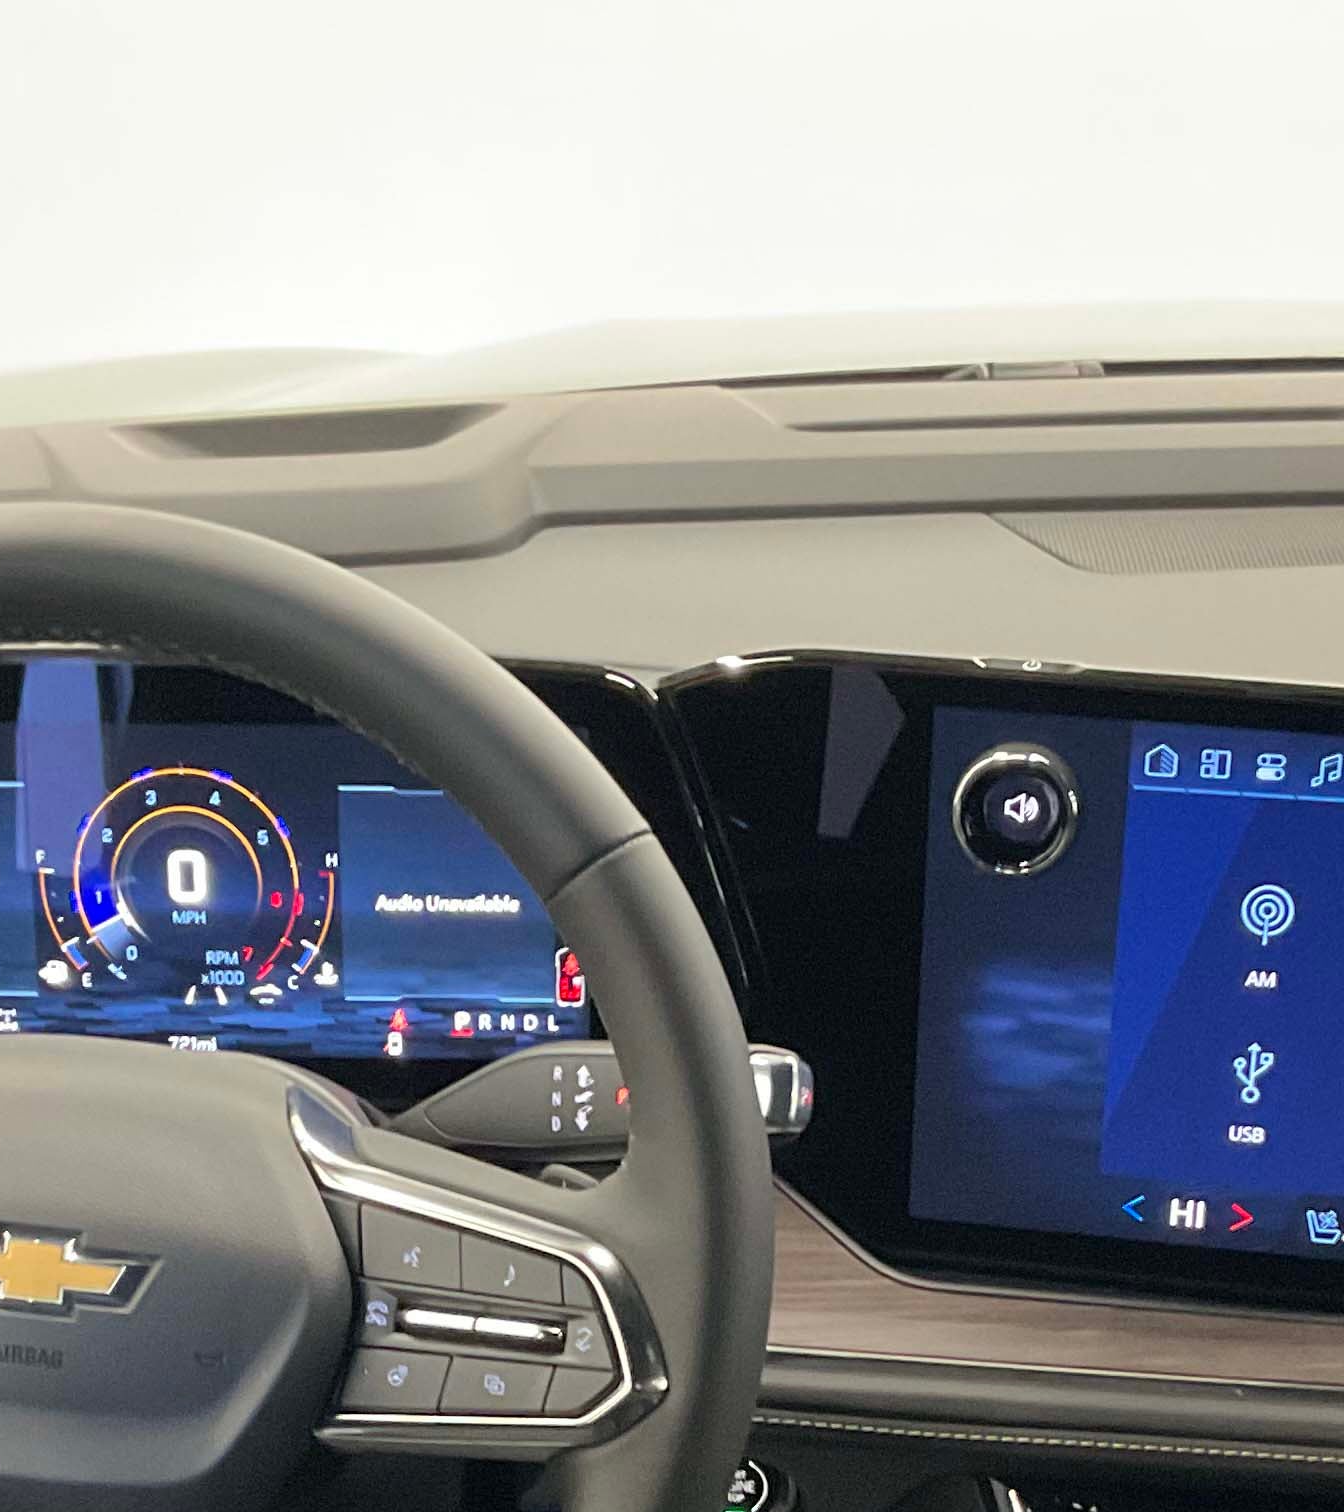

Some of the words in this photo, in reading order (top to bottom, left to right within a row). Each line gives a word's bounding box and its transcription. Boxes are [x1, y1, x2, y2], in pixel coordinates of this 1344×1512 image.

[145, 789, 157, 805] 3
[209, 789, 222, 805] 4
[101, 827, 113, 843] 2
[257, 829, 269, 846] 5
[35, 849, 46, 864] F
[325, 853, 340, 868] H
[166, 848, 207, 904] 0
[374, 894, 424, 912] Audio
[425, 894, 521, 913] Unavailable
[172, 911, 206, 925] MPH
[126, 945, 138, 961] 0
[206, 950, 239, 966] RPM
[243, 945, 254, 962] 7
[81, 972, 93, 989] E
[200, 971, 245, 986] x1000
[288, 975, 299, 991] C
[1244, 971, 1277, 990] AM
[454, 1011, 470, 1031] P
[478, 1013, 492, 1030] R
[501, 1013, 515, 1030] N
[523, 1013, 538, 1031] D
[547, 1013, 559, 1031] L
[1228, 1125, 1265, 1144] USB
[1169, 1198, 1205, 1230] HI
